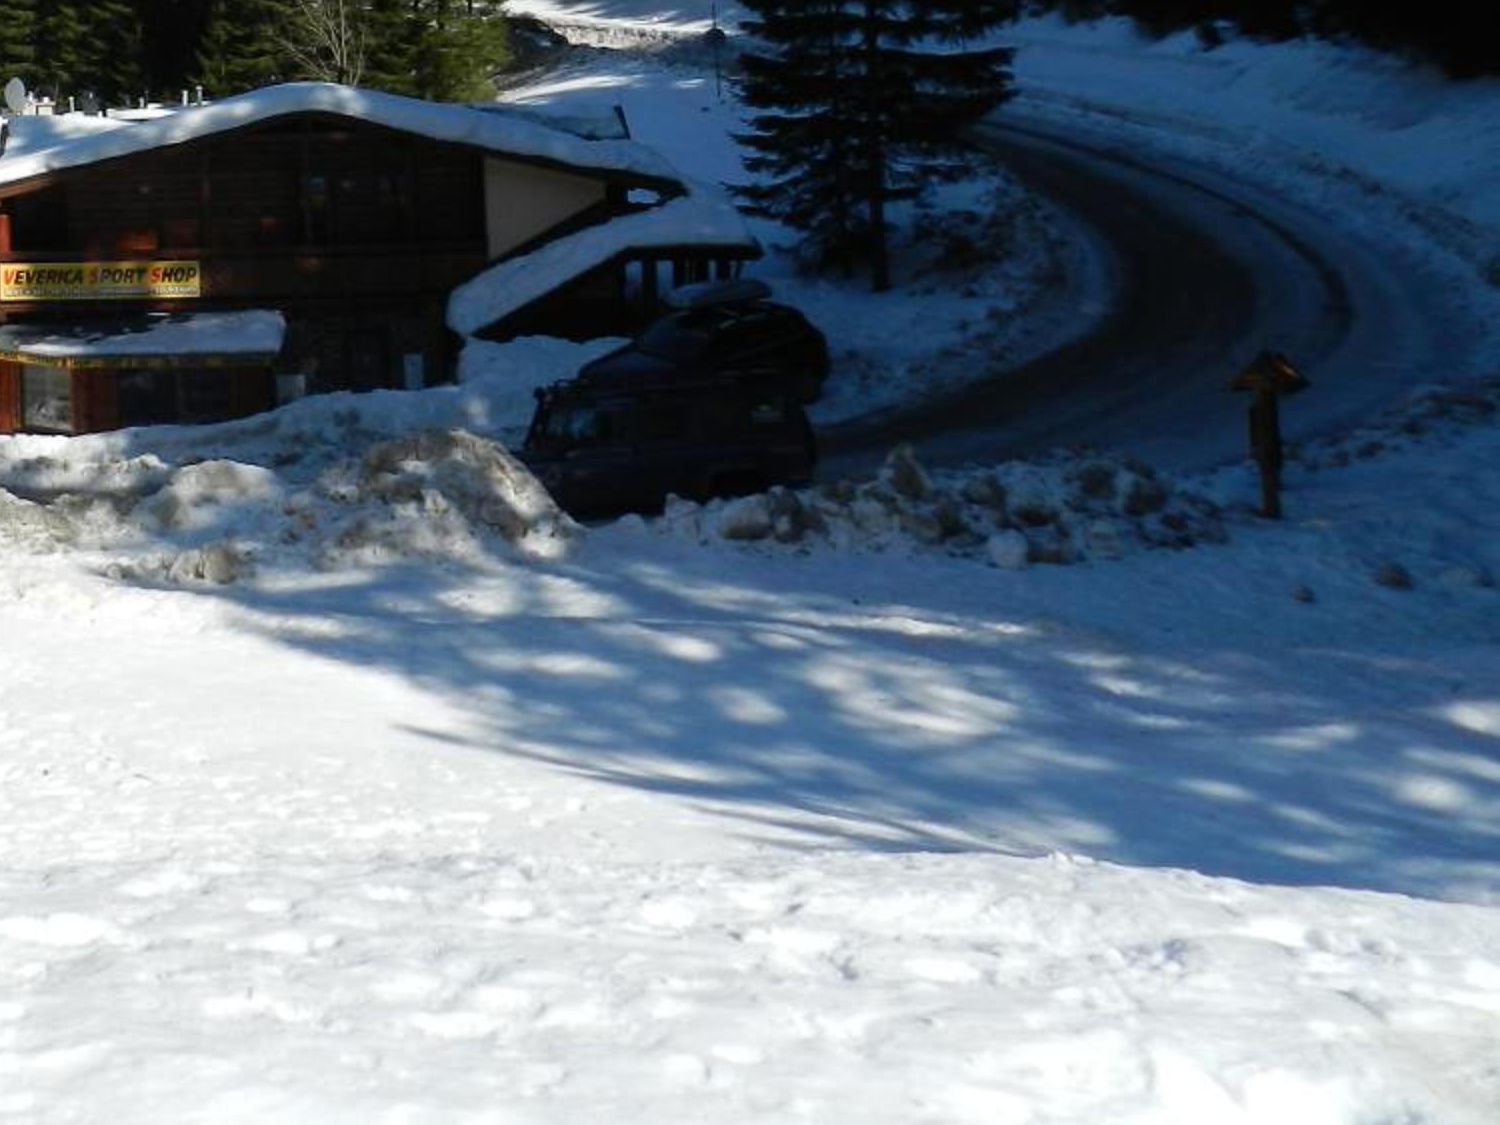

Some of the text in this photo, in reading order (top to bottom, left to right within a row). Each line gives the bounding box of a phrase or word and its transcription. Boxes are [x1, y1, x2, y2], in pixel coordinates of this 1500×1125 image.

[3, 266, 197, 285] VEVERICA SPORT SHOP
